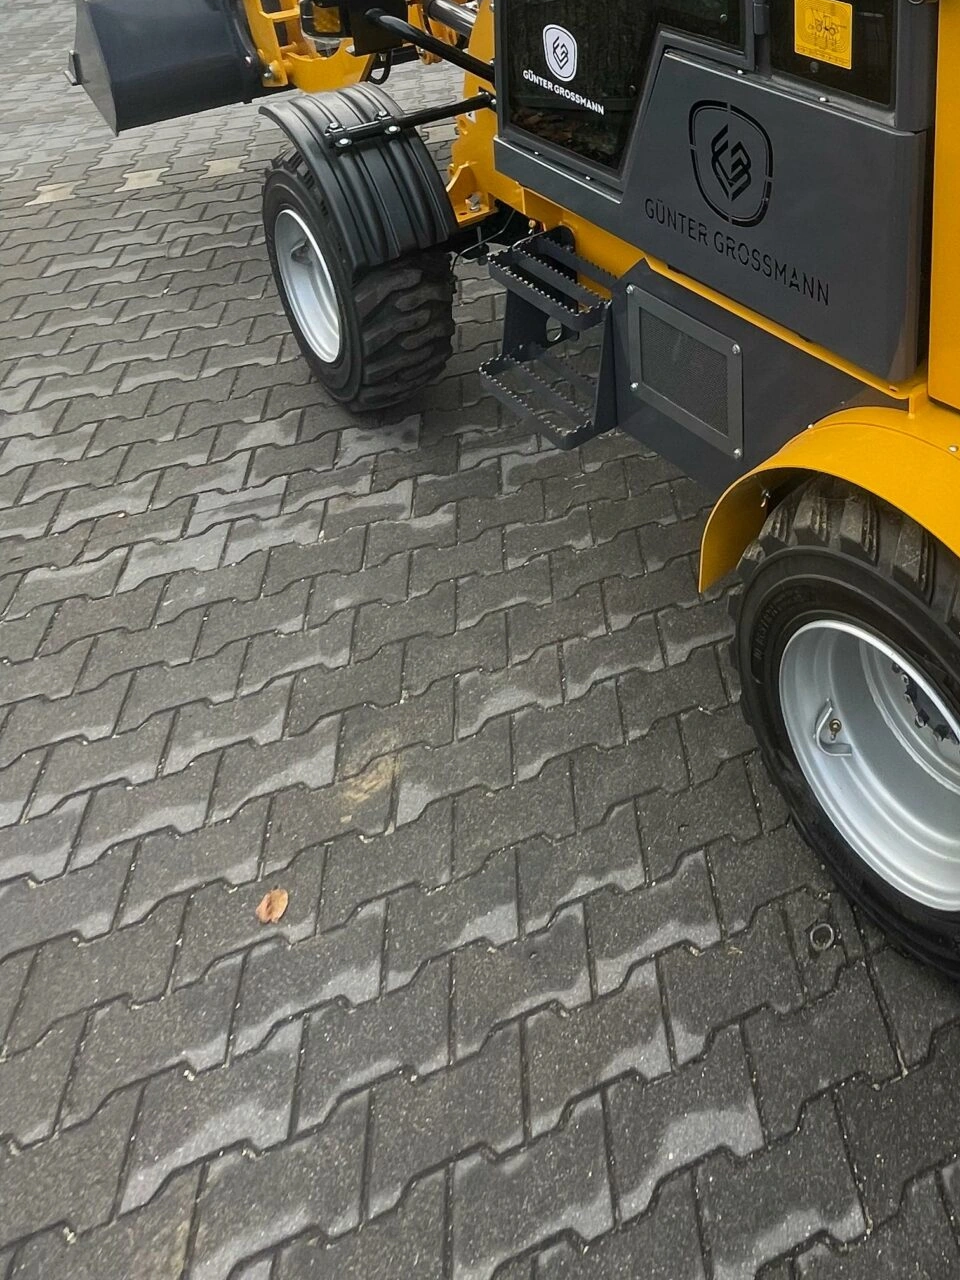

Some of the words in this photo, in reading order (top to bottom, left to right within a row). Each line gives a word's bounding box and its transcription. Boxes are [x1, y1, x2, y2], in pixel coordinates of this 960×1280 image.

[522, 70, 554, 91] GÜNTER
[553, 84, 605, 116] GROSSMANN
[645, 198, 709, 247] GÜNTER
[713, 231, 830, 306] GROSSMANN
